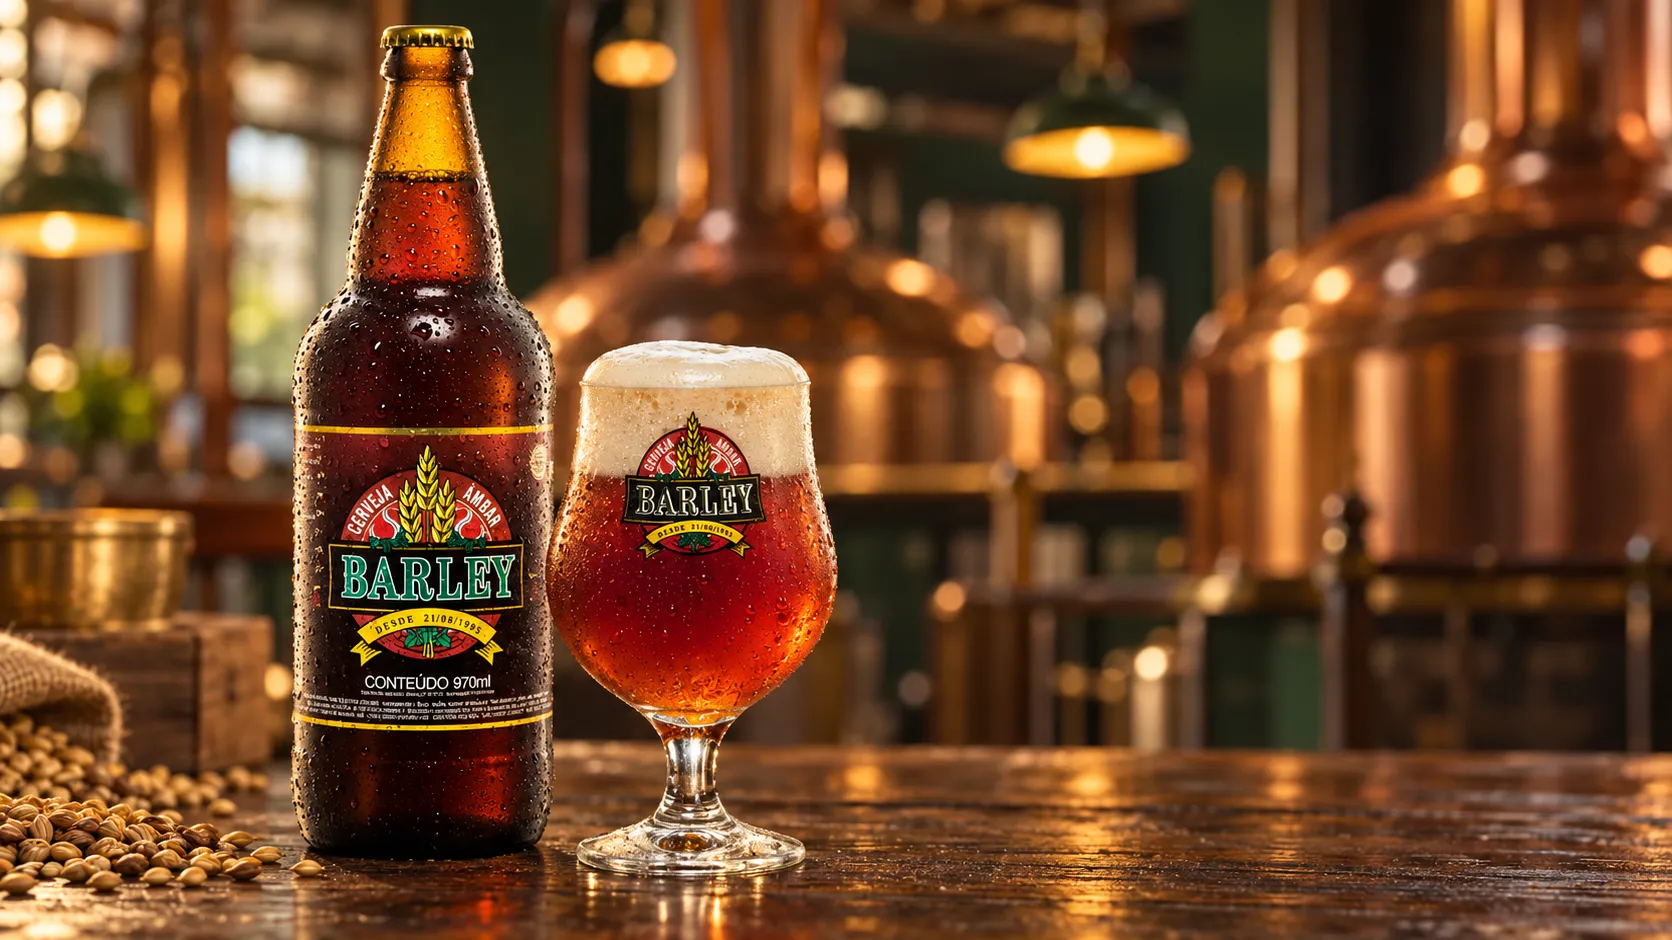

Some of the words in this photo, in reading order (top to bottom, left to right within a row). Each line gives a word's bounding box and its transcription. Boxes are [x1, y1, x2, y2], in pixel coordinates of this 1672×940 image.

[347, 484, 394, 535] CERVEJA
[462, 482, 502, 528] ÂMBAR
[635, 483, 753, 517] BARLEY
[341, 554, 516, 602] BARLEY
[374, 615, 414, 634] DESDE
[423, 613, 482, 635] 21/08/1995
[364, 673, 449, 690] CONTEÚDO
[453, 674, 492, 690] 970ml
